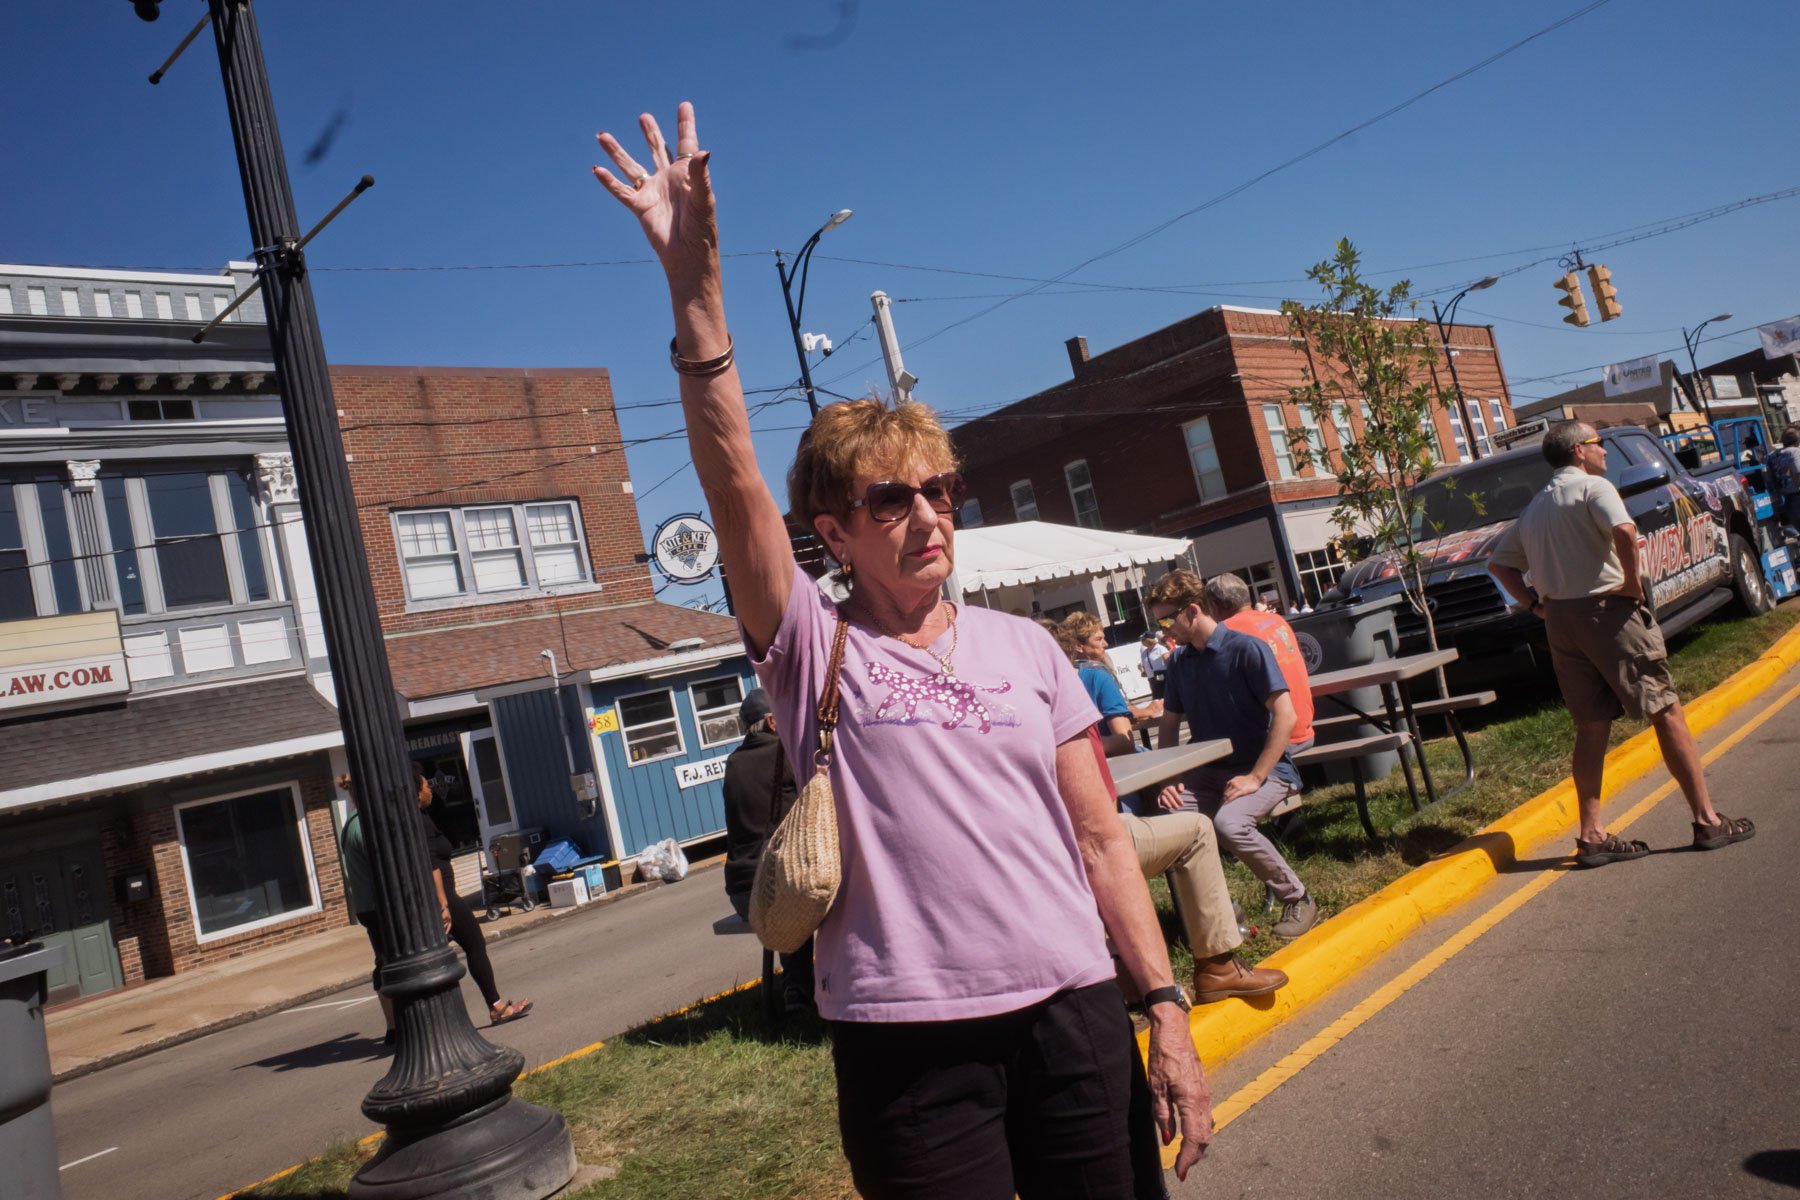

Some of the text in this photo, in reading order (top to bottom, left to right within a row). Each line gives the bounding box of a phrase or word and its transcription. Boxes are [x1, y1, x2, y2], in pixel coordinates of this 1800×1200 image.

[661, 534, 681, 550] KITE
[691, 531, 709, 544] KEY
[595, 716, 611, 730] 58
[683, 767, 703, 782] F.J.
